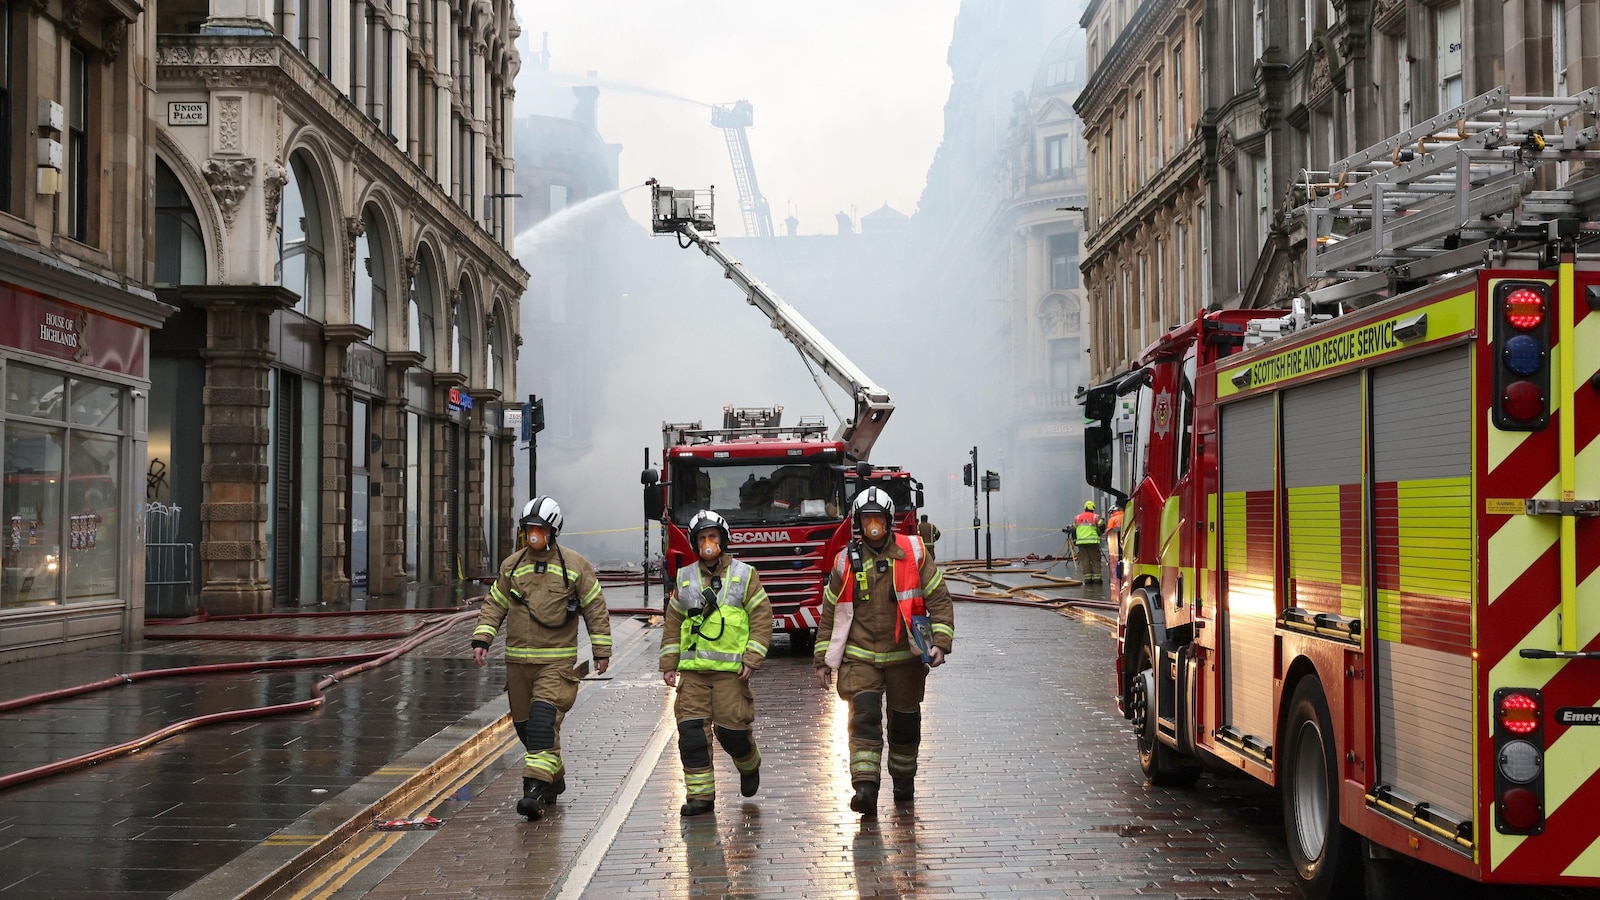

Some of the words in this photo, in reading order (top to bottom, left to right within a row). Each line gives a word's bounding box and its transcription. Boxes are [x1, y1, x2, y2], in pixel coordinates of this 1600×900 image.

[46, 313, 65, 328] HOUSE
[65, 318, 74, 331] OF
[40, 324, 77, 347] HIGHLANDS
[1253, 356, 1284, 385] SCOTTISH
[1287, 350, 1302, 377] FIRE
[1303, 345, 1321, 371] AND
[1322, 333, 1355, 367] RESCUE
[1357, 320, 1397, 356] SERVICE
[731, 531, 791, 544] SCANIA
